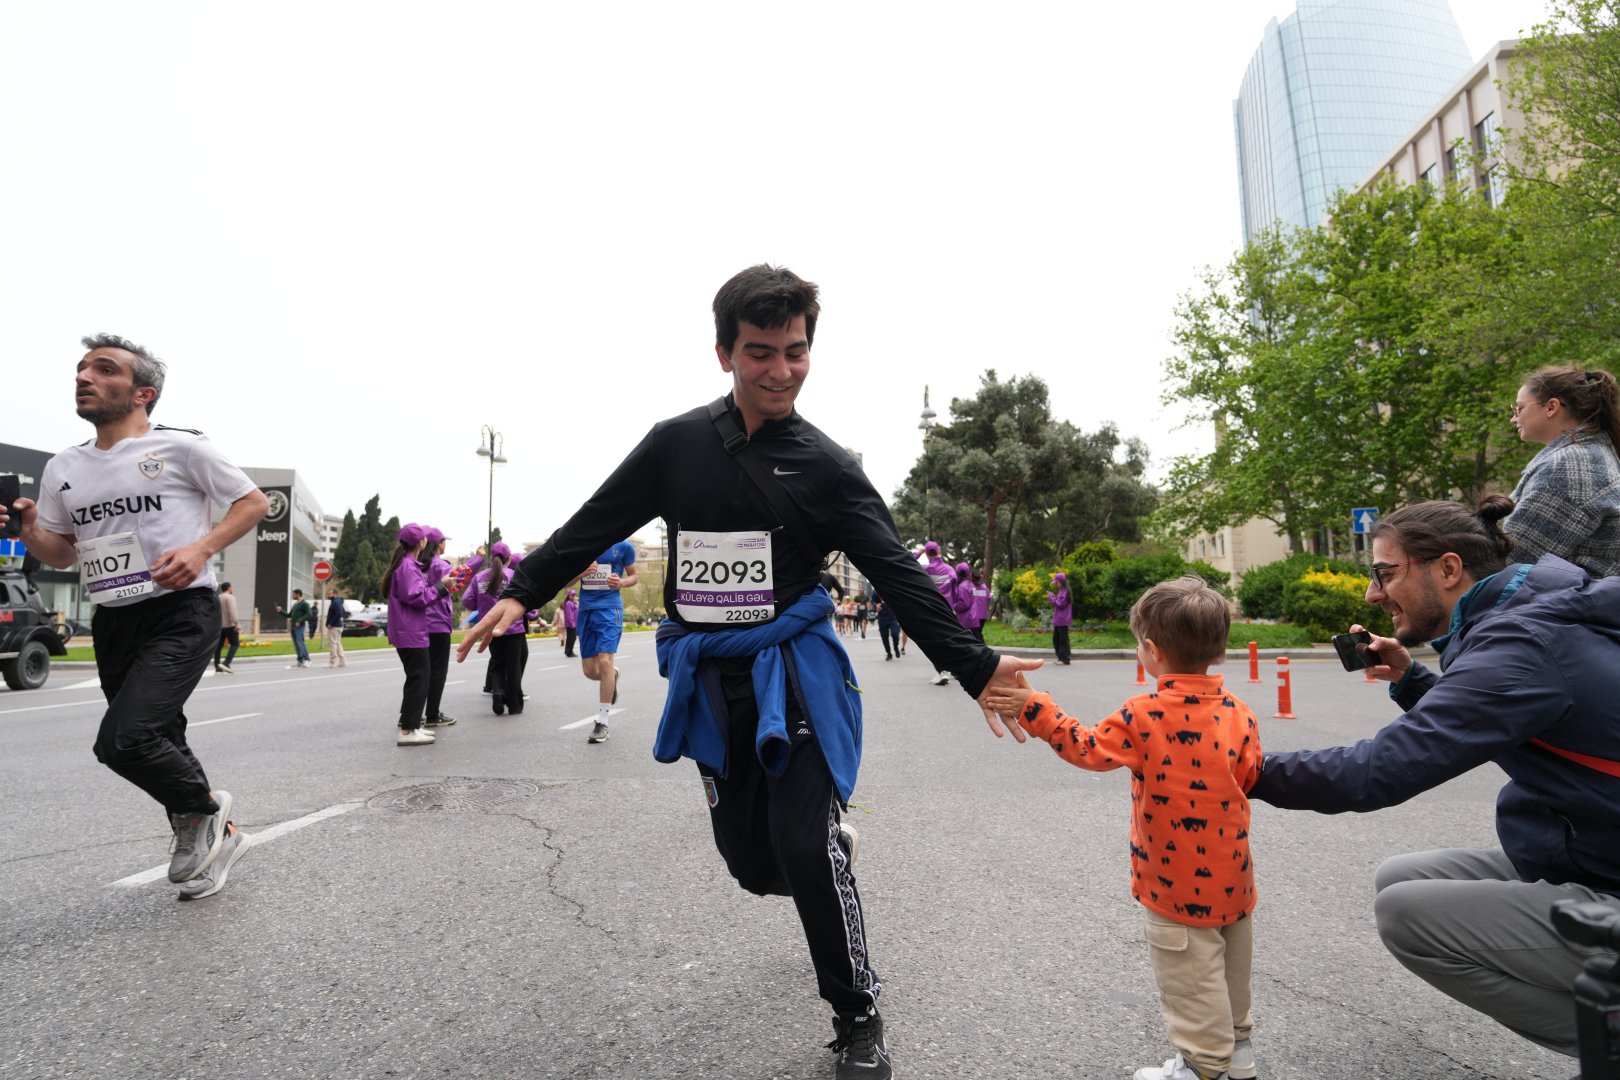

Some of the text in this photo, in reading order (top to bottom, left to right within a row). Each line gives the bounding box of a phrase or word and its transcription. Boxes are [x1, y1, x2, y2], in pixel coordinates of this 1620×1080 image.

[257, 530, 288, 543] Jeep
[83, 552, 131, 578] 21107
[680, 559, 767, 584] 22093
[114, 584, 145, 598] 21107
[680, 591, 766, 604] KÜLƏYƏ QALİB GƏL
[725, 608, 769, 621] 22093
